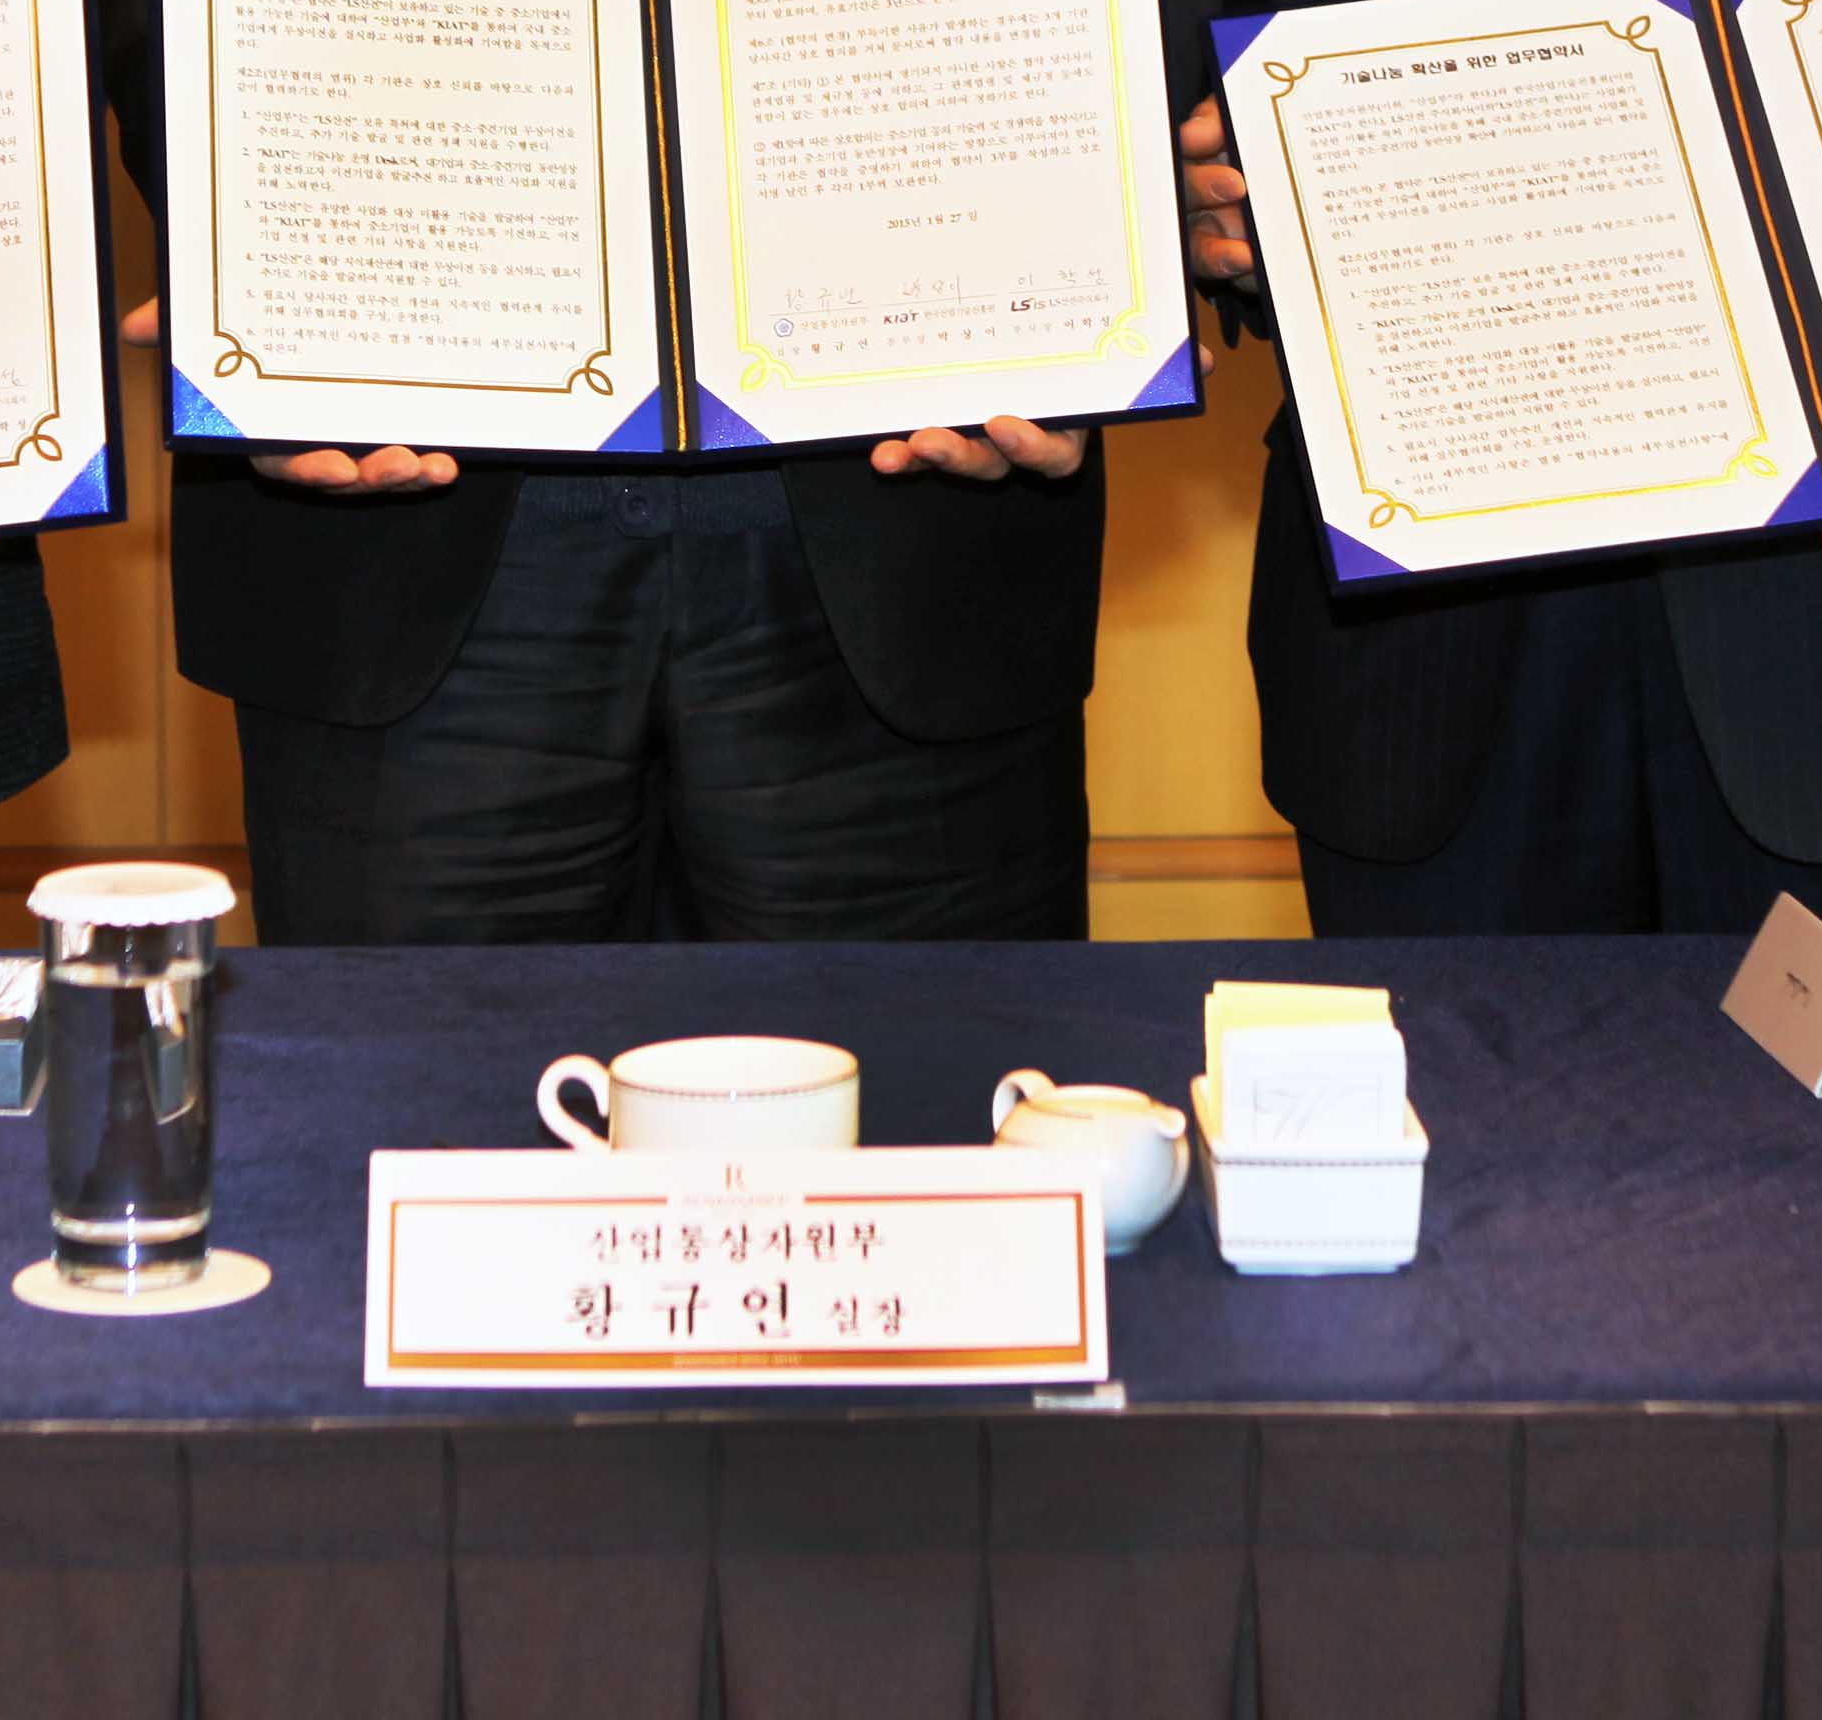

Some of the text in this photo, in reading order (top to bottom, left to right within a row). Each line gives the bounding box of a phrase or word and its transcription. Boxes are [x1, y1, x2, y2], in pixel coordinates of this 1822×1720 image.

[1340, 42, 1586, 86] 기술나눔 확산을 위한 업무협약서
[590, 1218, 888, 1265] 산업통상자원부
